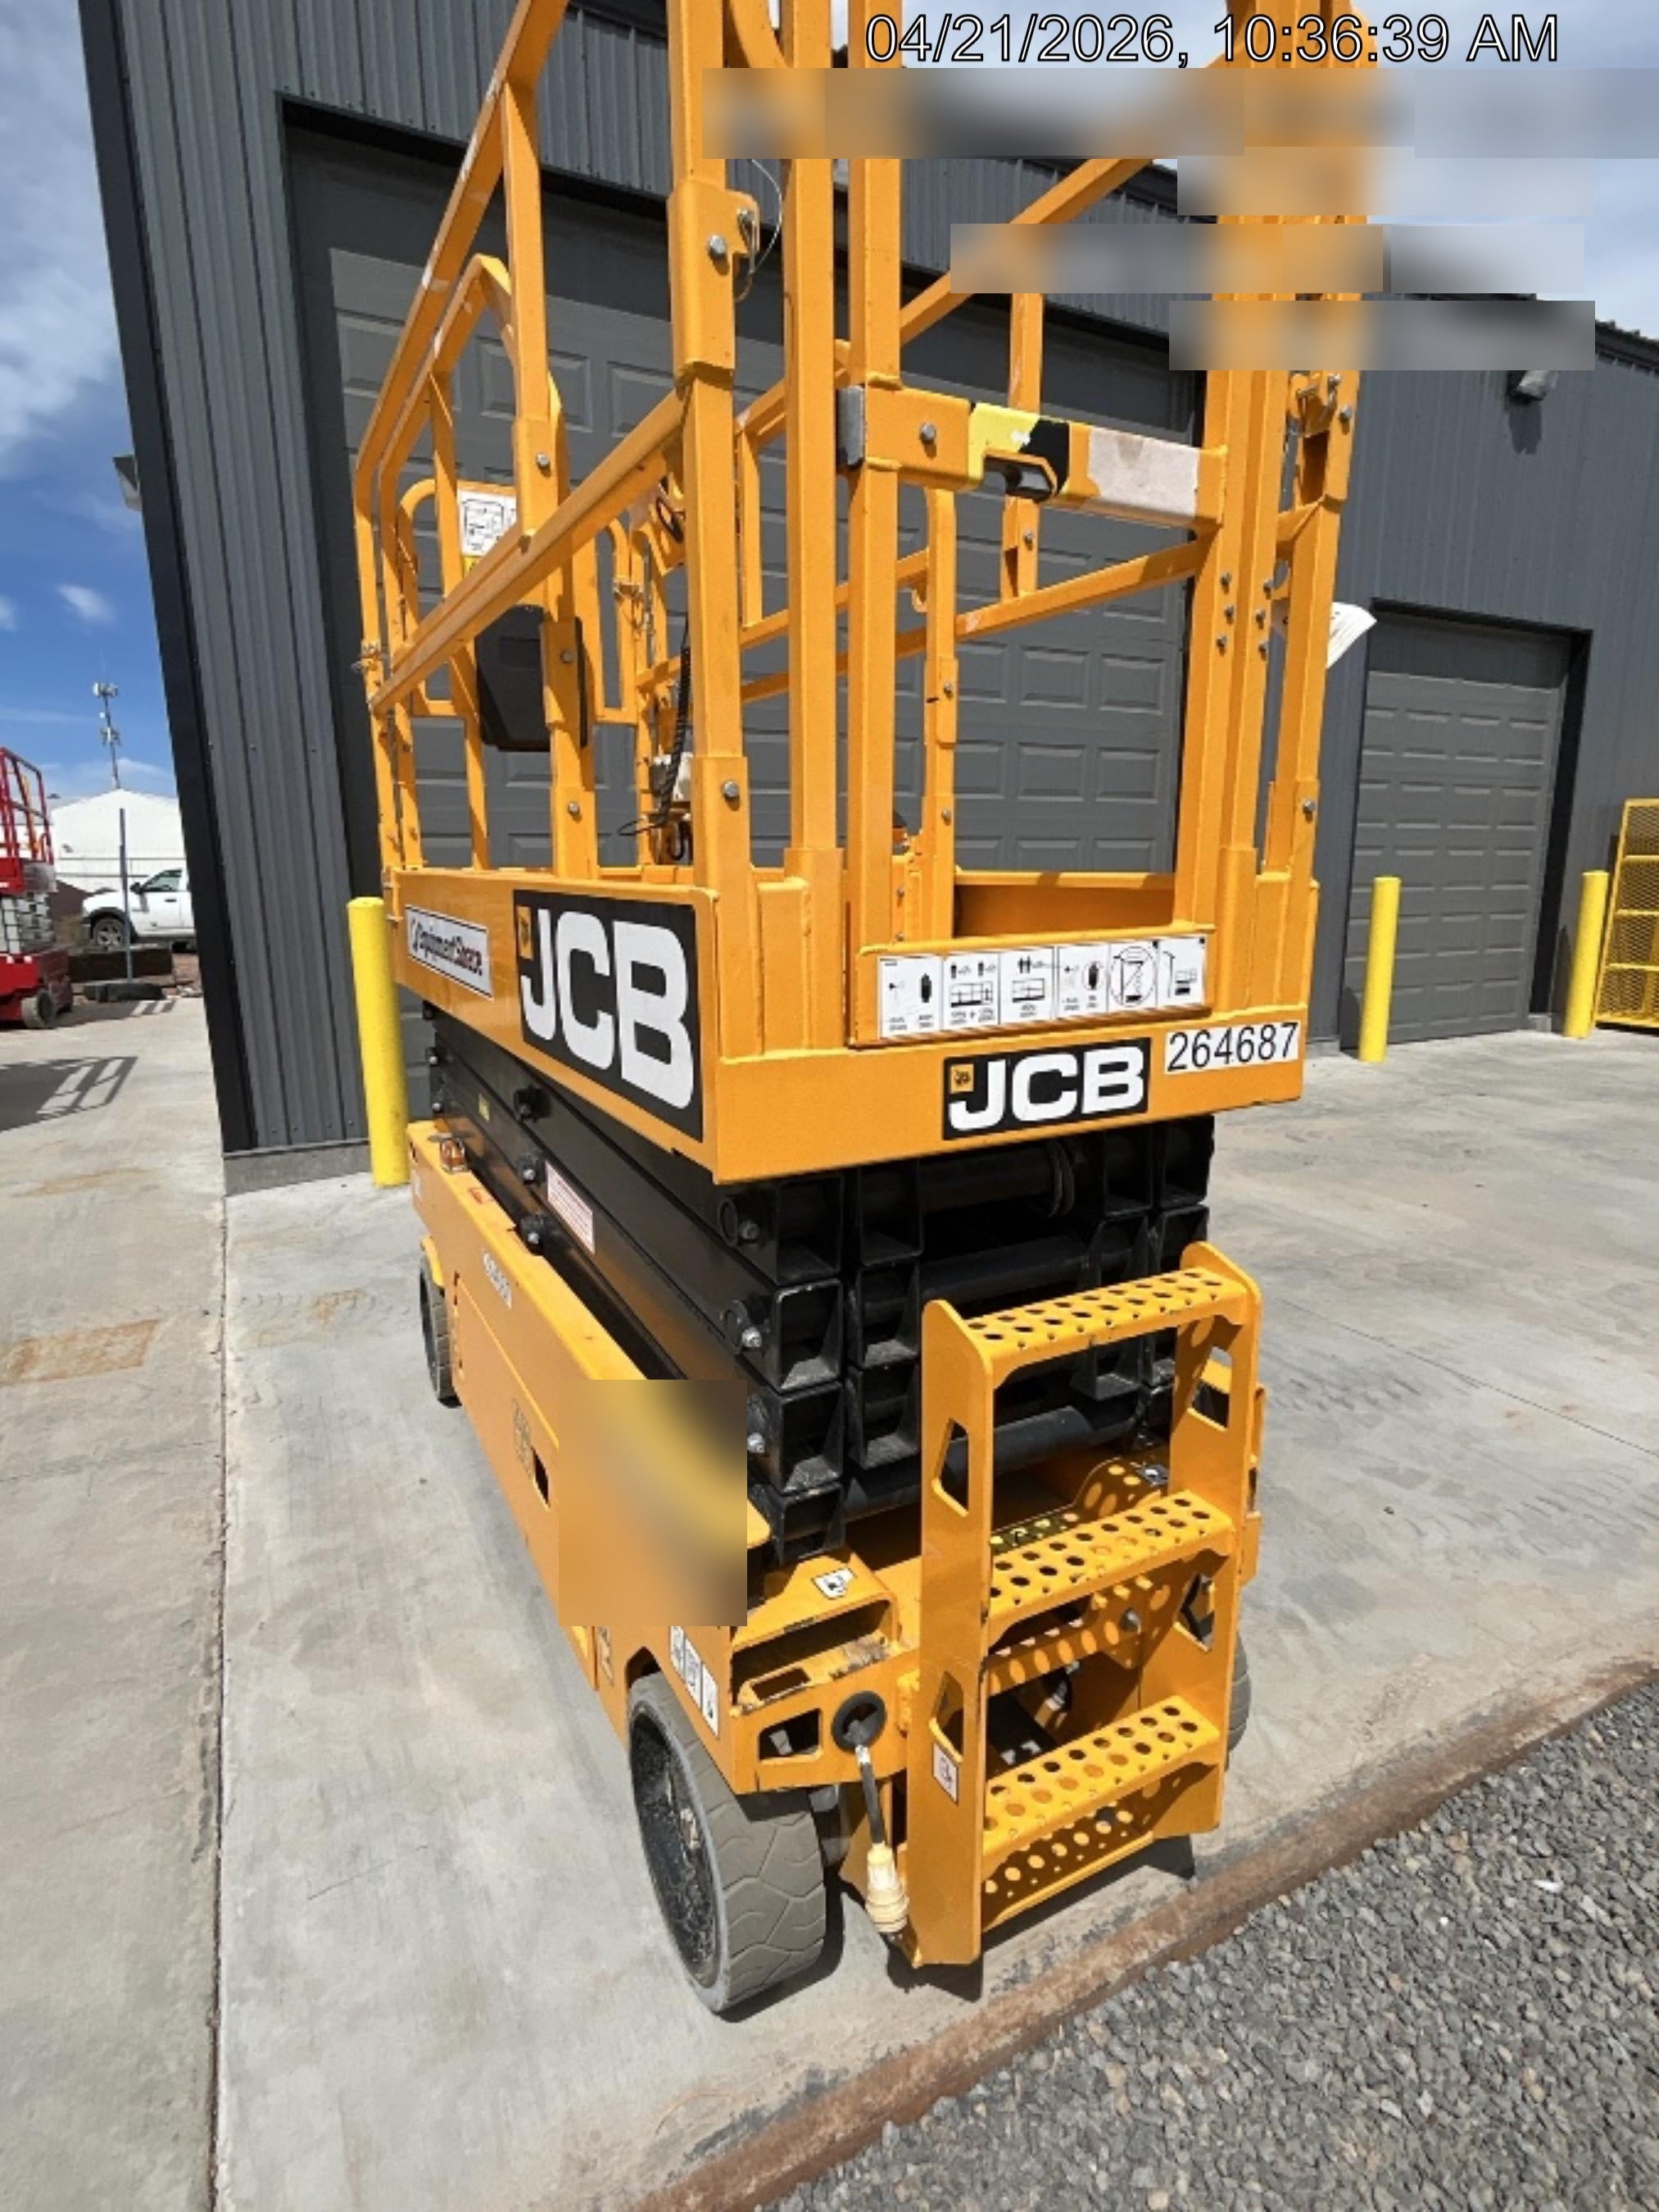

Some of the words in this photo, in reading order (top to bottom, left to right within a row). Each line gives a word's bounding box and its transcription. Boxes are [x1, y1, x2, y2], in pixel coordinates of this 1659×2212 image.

[520, 908, 695, 1109] JCB
[1167, 1022, 1299, 1072] 264687
[949, 1046, 1145, 1131] JCB
